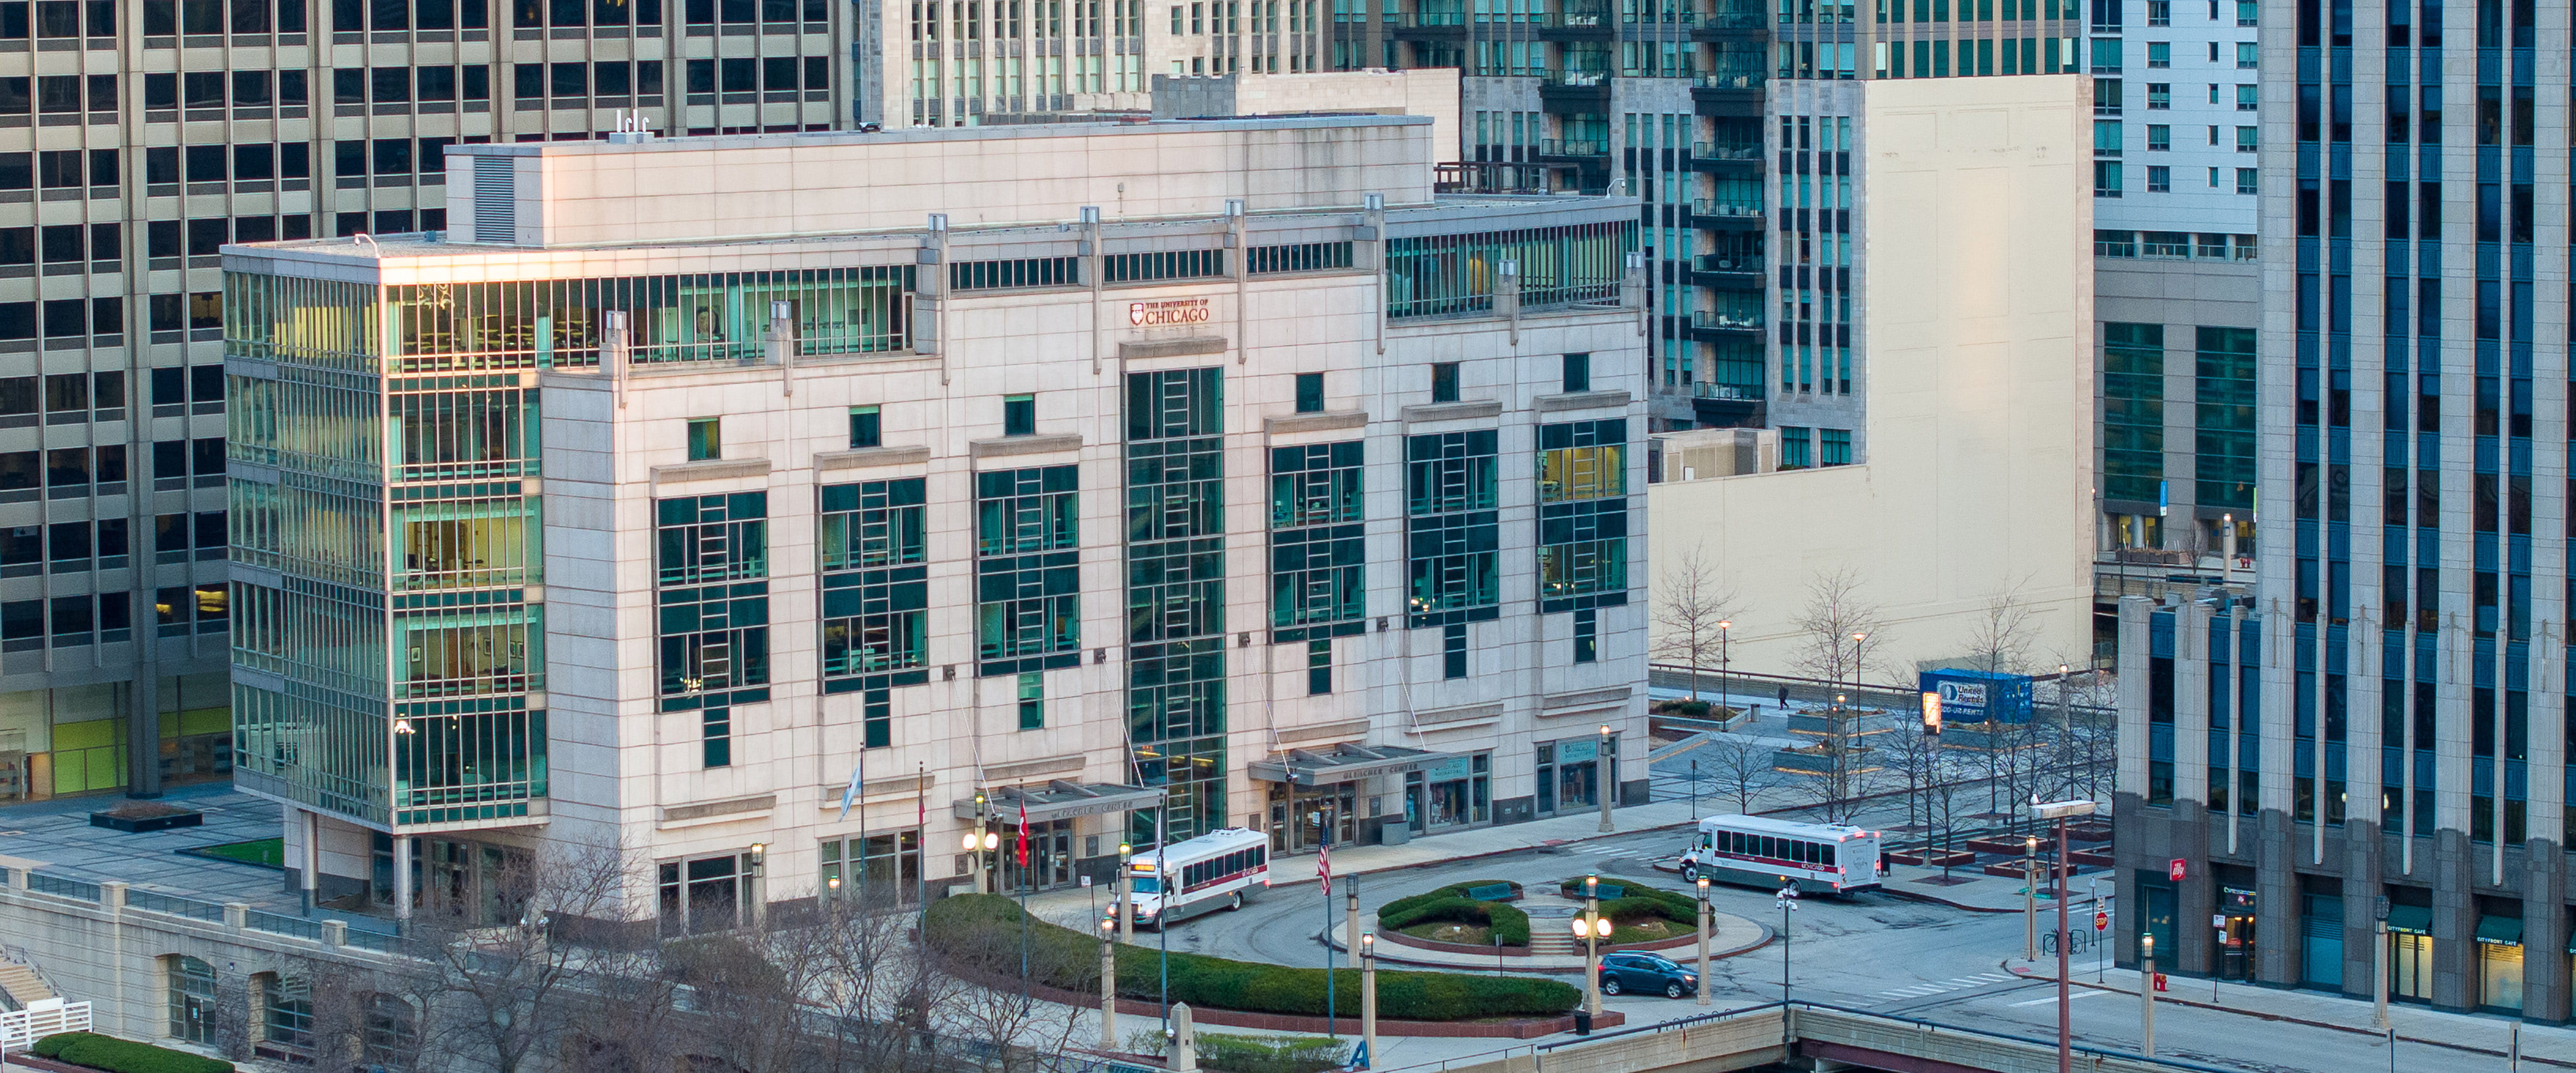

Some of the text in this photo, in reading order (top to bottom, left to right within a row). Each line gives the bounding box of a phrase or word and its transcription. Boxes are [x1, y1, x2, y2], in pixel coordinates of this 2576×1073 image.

[1161, 299, 1198, 309] UNIVERSITY
[1146, 308, 1209, 325] CHICAGO
[1958, 686, 1982, 694] United
[1958, 694, 1984, 704] Rentals
[1389, 763, 1418, 773] CENTER
[2173, 863, 2184, 878] illy
[2096, 917, 2107, 926] STOP
